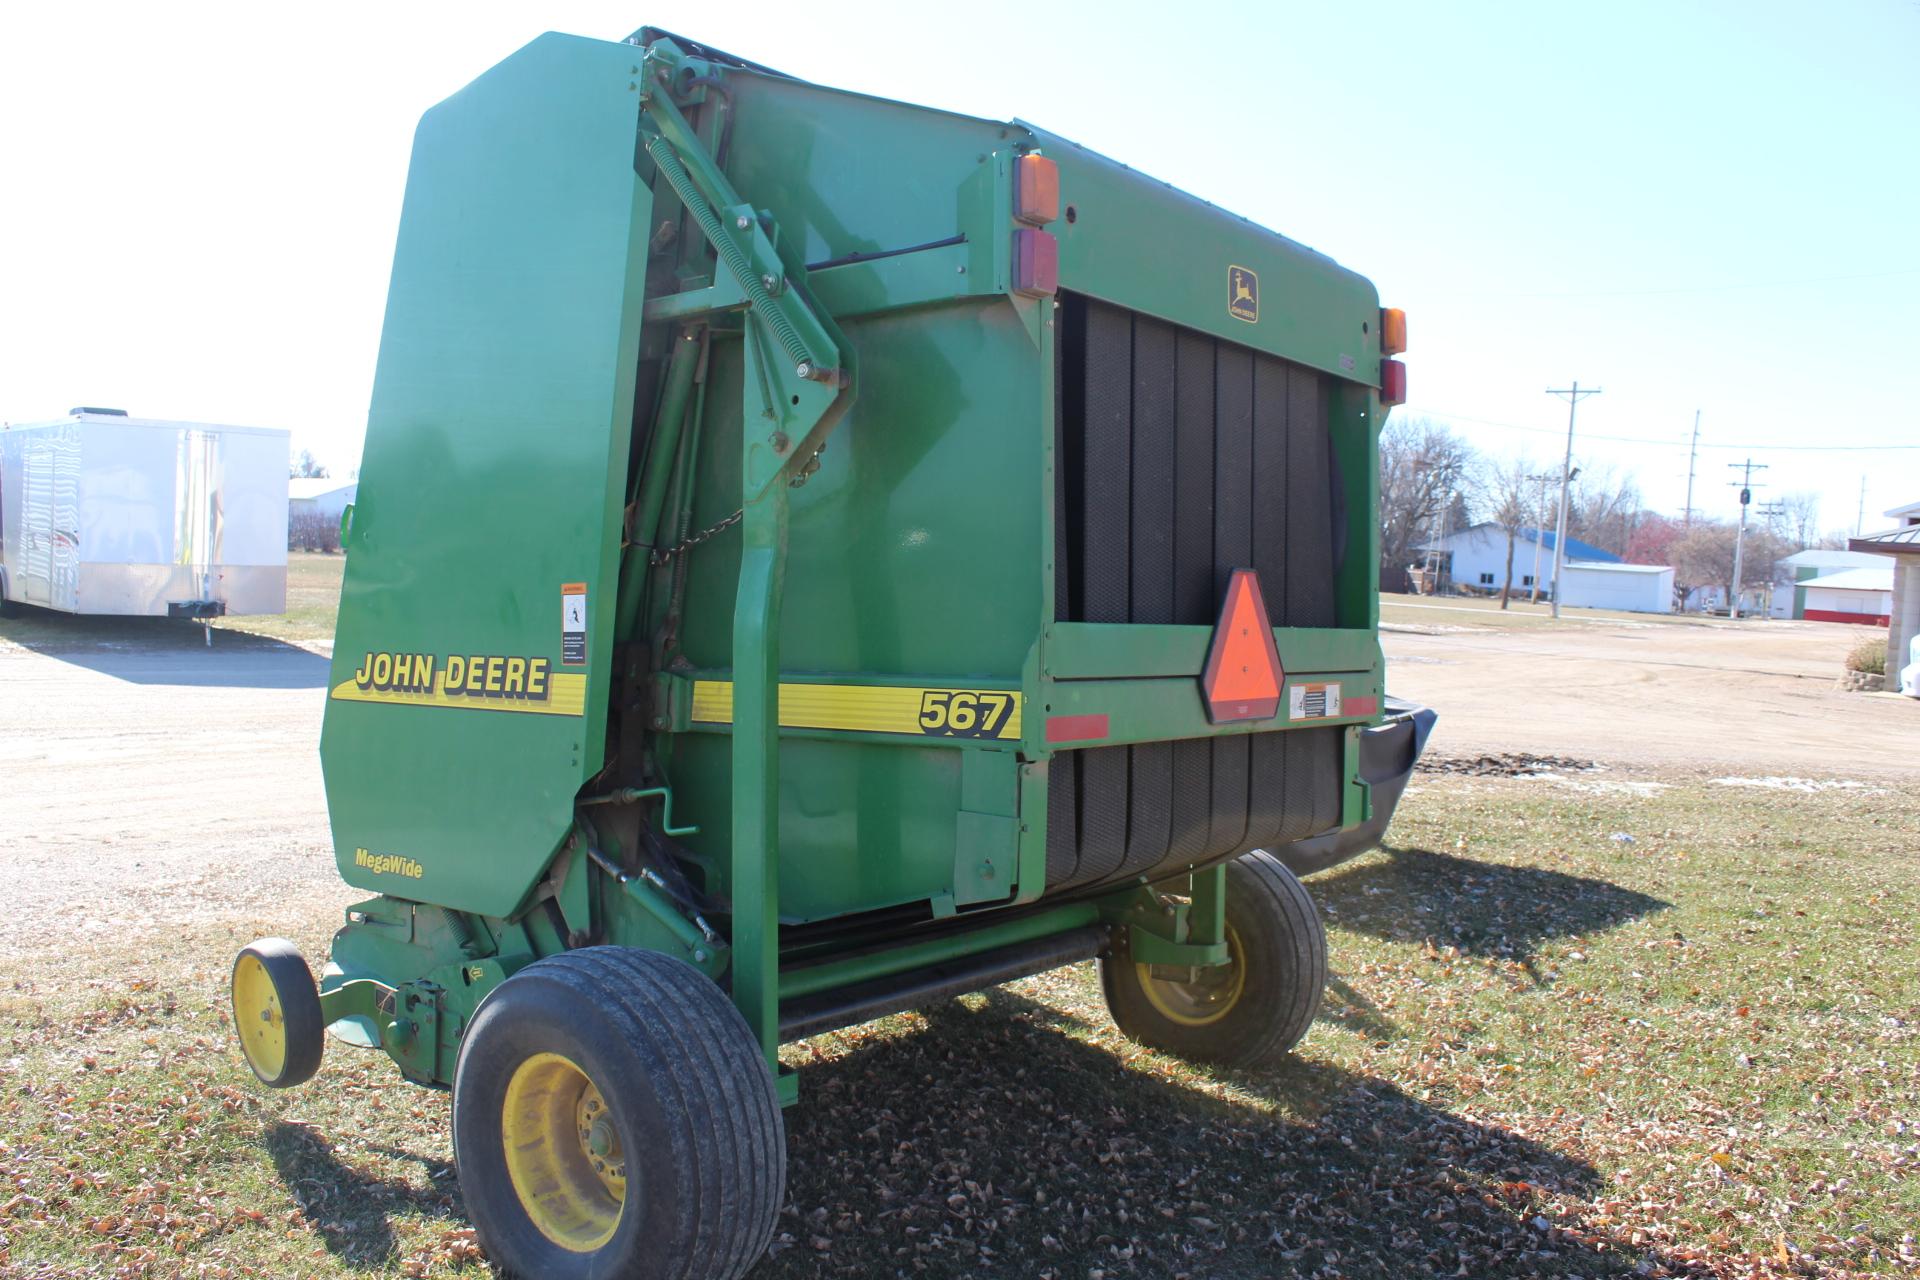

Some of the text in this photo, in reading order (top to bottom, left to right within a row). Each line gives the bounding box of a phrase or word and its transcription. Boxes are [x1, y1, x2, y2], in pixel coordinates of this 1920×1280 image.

[355, 652, 549, 699] JOHN DEERE
[919, 691, 1014, 736] 567
[355, 848, 424, 878] MegaWide
